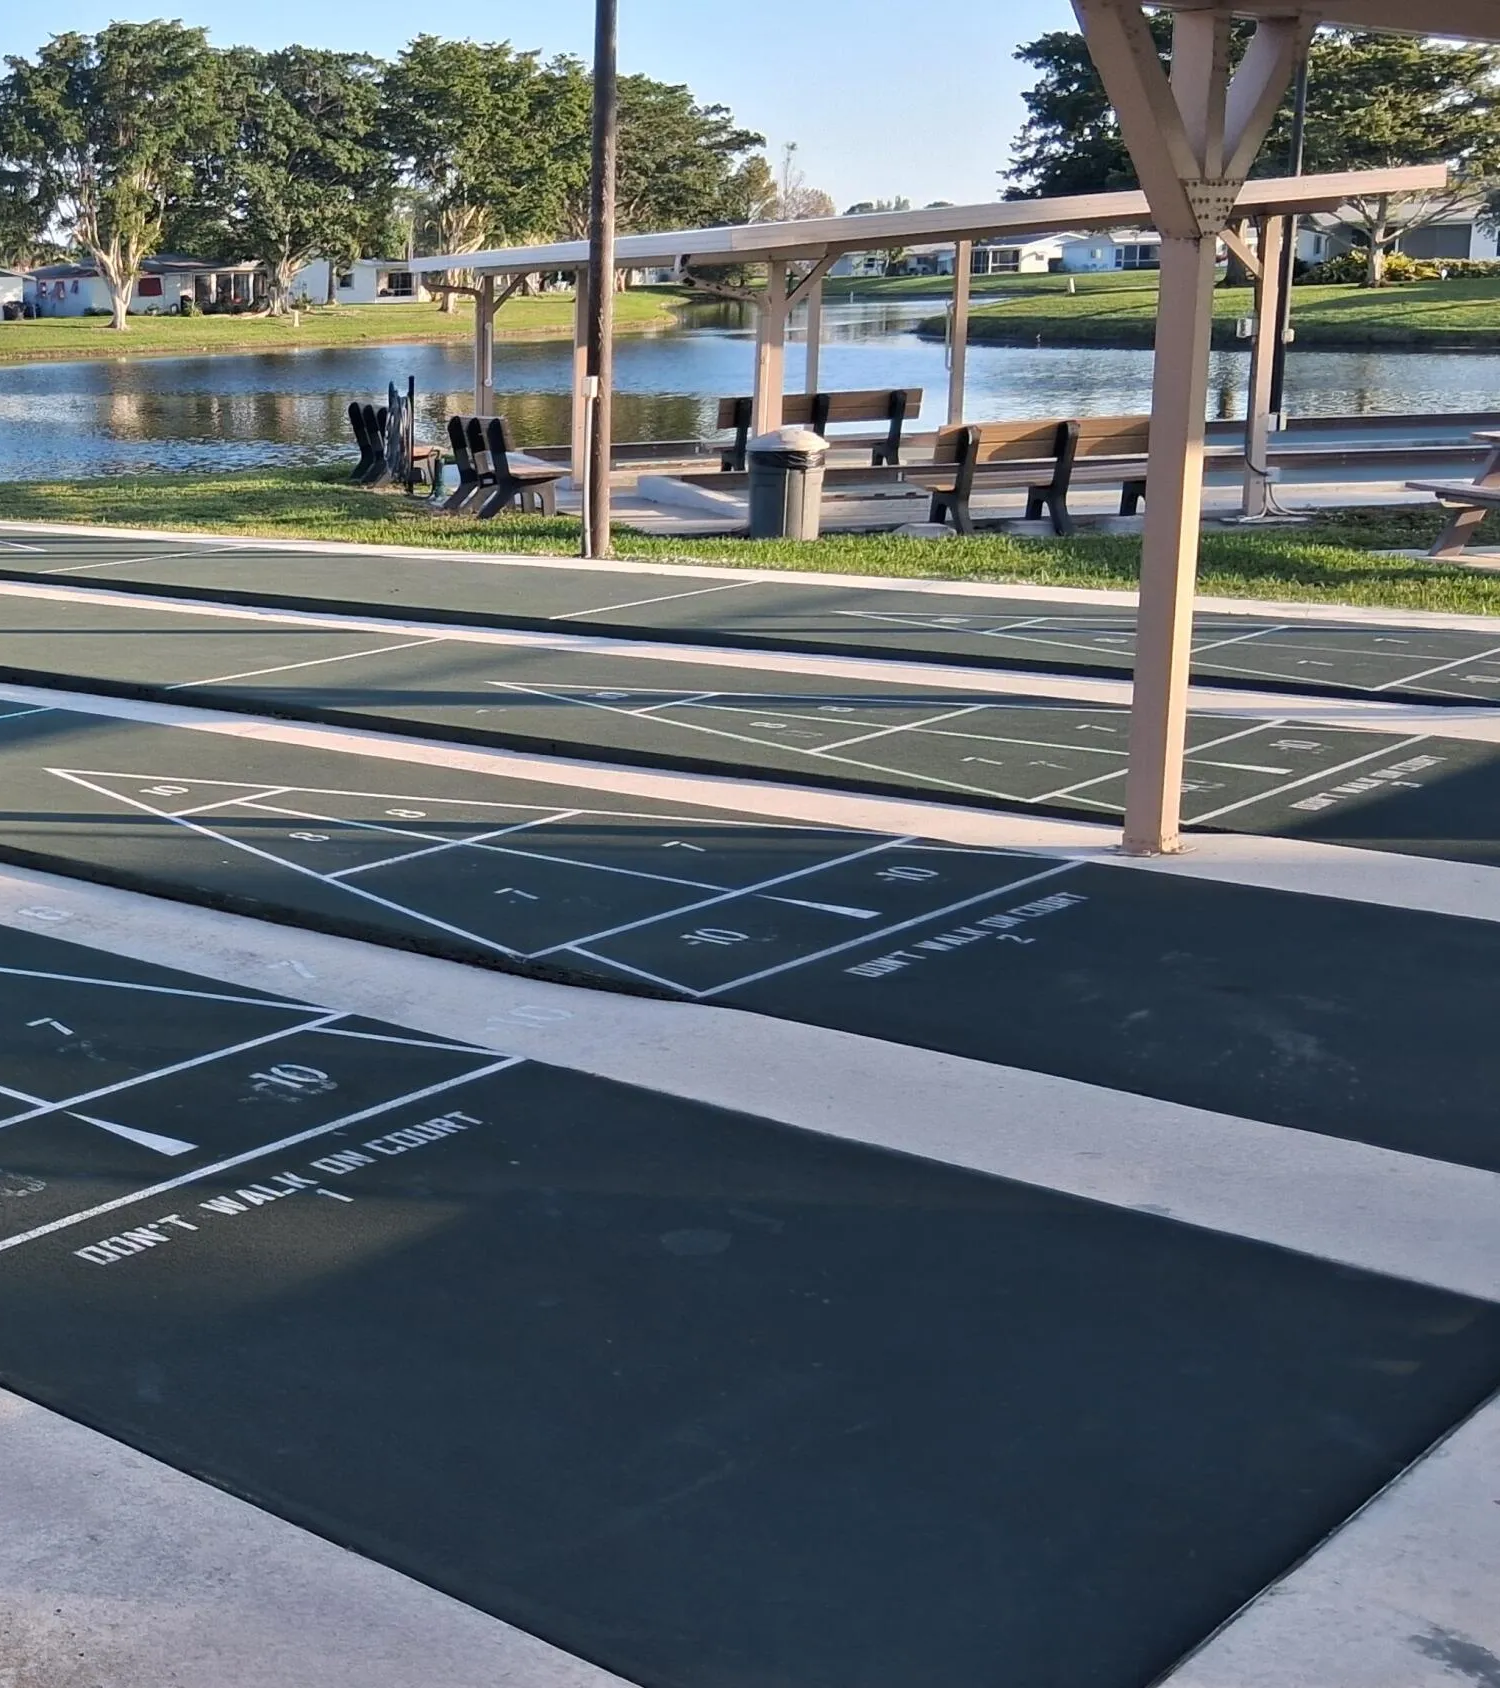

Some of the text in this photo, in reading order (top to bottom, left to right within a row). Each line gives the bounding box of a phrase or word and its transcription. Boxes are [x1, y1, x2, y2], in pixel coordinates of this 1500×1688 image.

[139, 785, 189, 797] 10
[385, 808, 427, 818] 8
[288, 831, 330, 842] 8
[660, 840, 706, 853] 7
[493, 887, 539, 900] 7
[911, 926, 994, 951] WALK
[996, 934, 1037, 944] 2
[25, 1016, 75, 1037] 7
[72, 1110, 485, 1266] DON'T WALK ON COURT
[315, 1187, 354, 1203] 1
